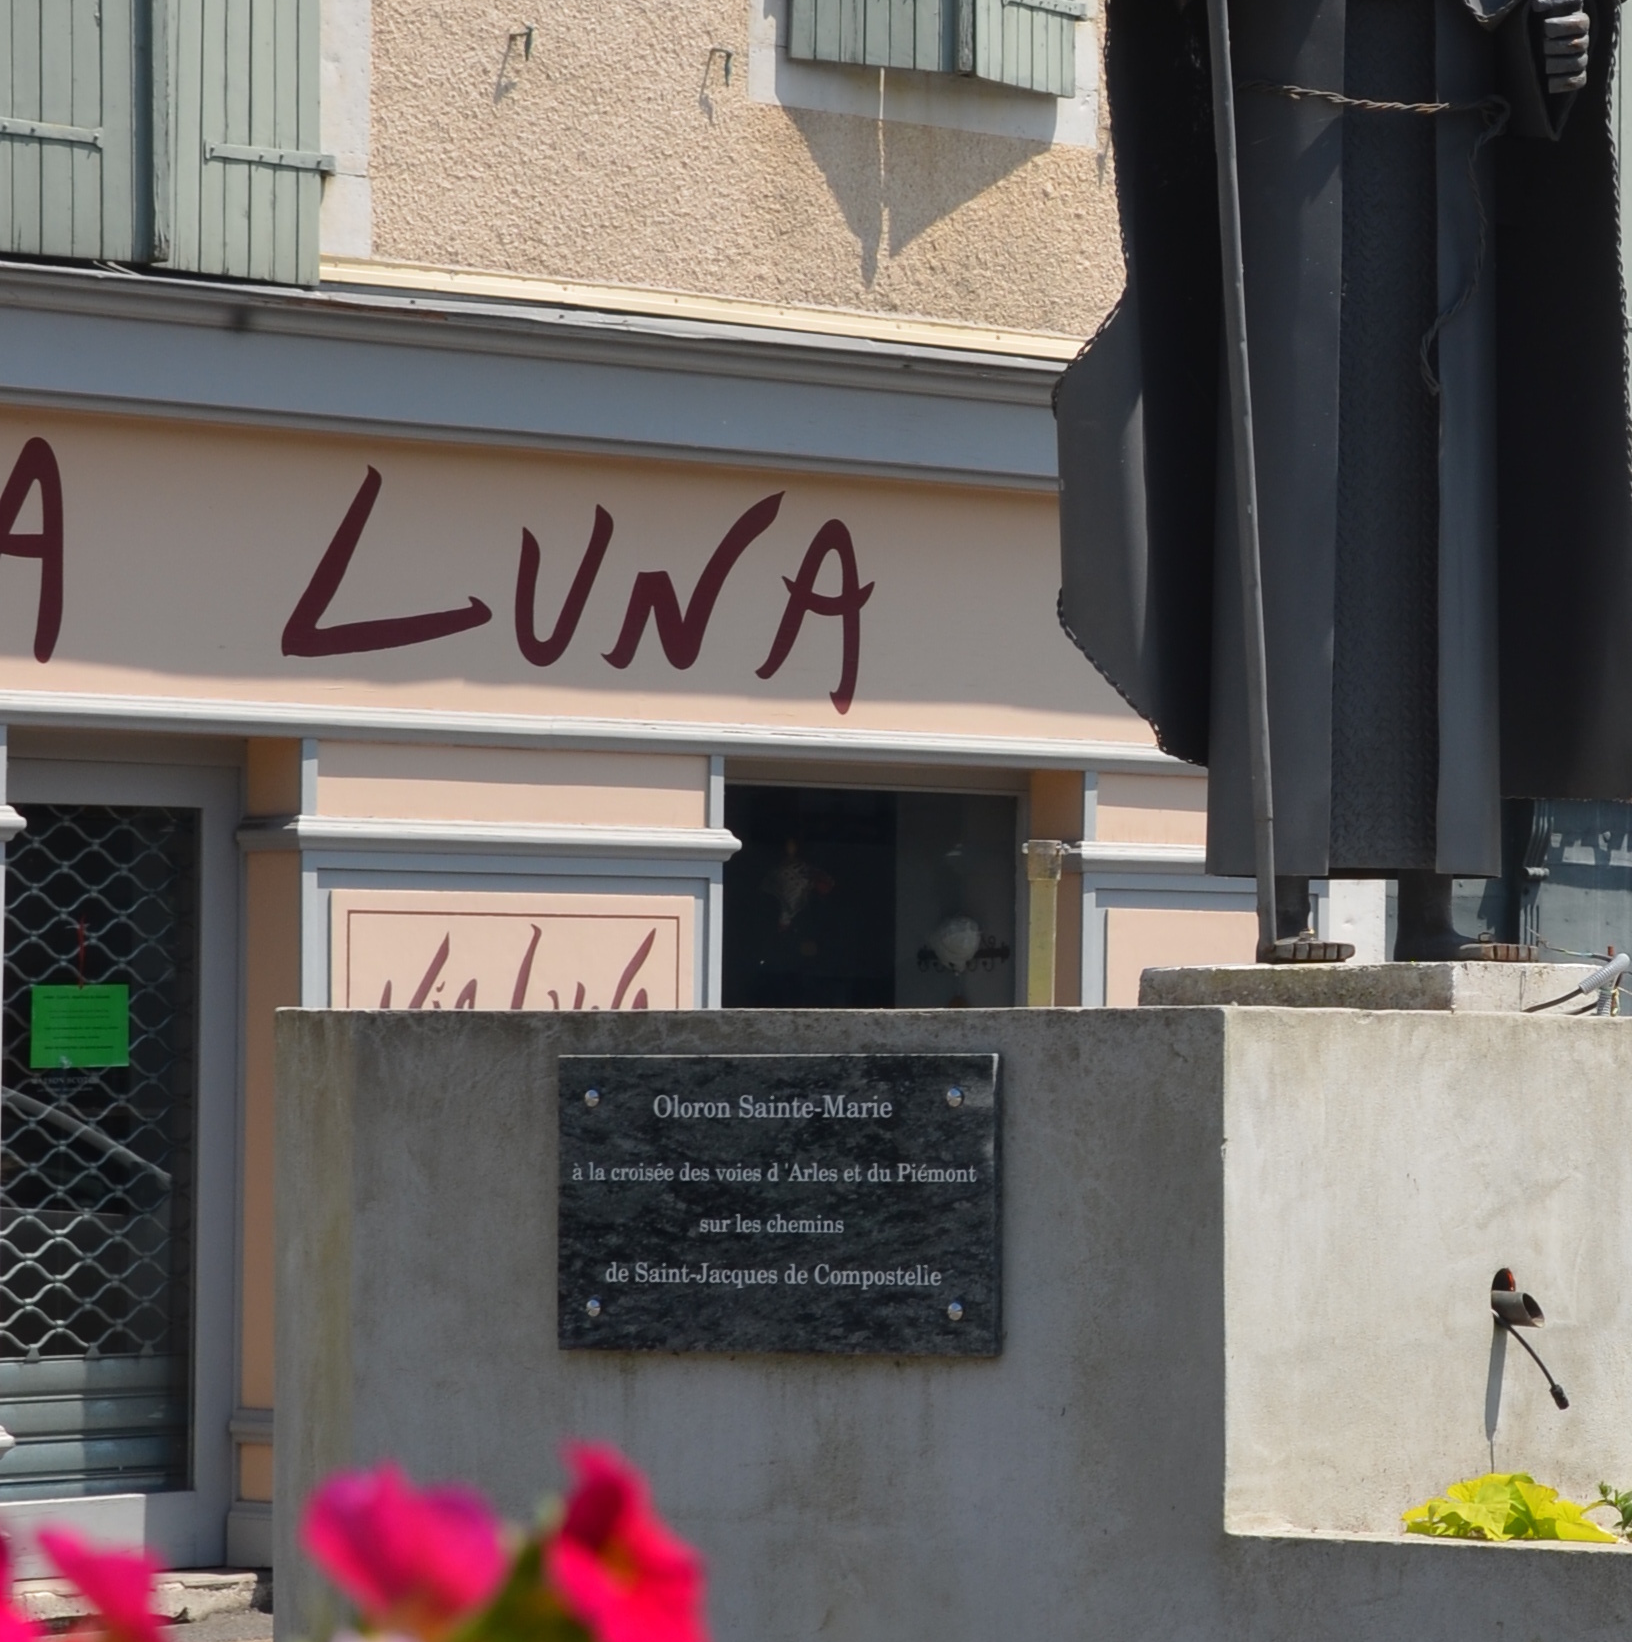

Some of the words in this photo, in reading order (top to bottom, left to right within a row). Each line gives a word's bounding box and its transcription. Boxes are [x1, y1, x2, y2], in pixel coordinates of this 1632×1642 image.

[281, 463, 876, 715] LUNA
[653, 1094, 732, 1119] Oloron
[738, 1094, 893, 1119] Sainte-Marie
[571, 1162, 584, 1181] à
[588, 1161, 606, 1181] la
[610, 1162, 675, 1182] croisée
[679, 1162, 710, 1182] des
[715, 1163, 762, 1182] voies
[843, 1164, 863, 1183] et
[867, 1162, 892, 1183] du
[896, 1163, 977, 1184] Piémont
[699, 1218, 731, 1233] sur
[735, 1213, 762, 1233] les
[766, 1213, 845, 1234] chemins
[605, 1261, 629, 1283] de
[635, 1261, 778, 1289] Saint-Jacques
[784, 1263, 809, 1285] de
[814, 1263, 942, 1291] Compostelle
